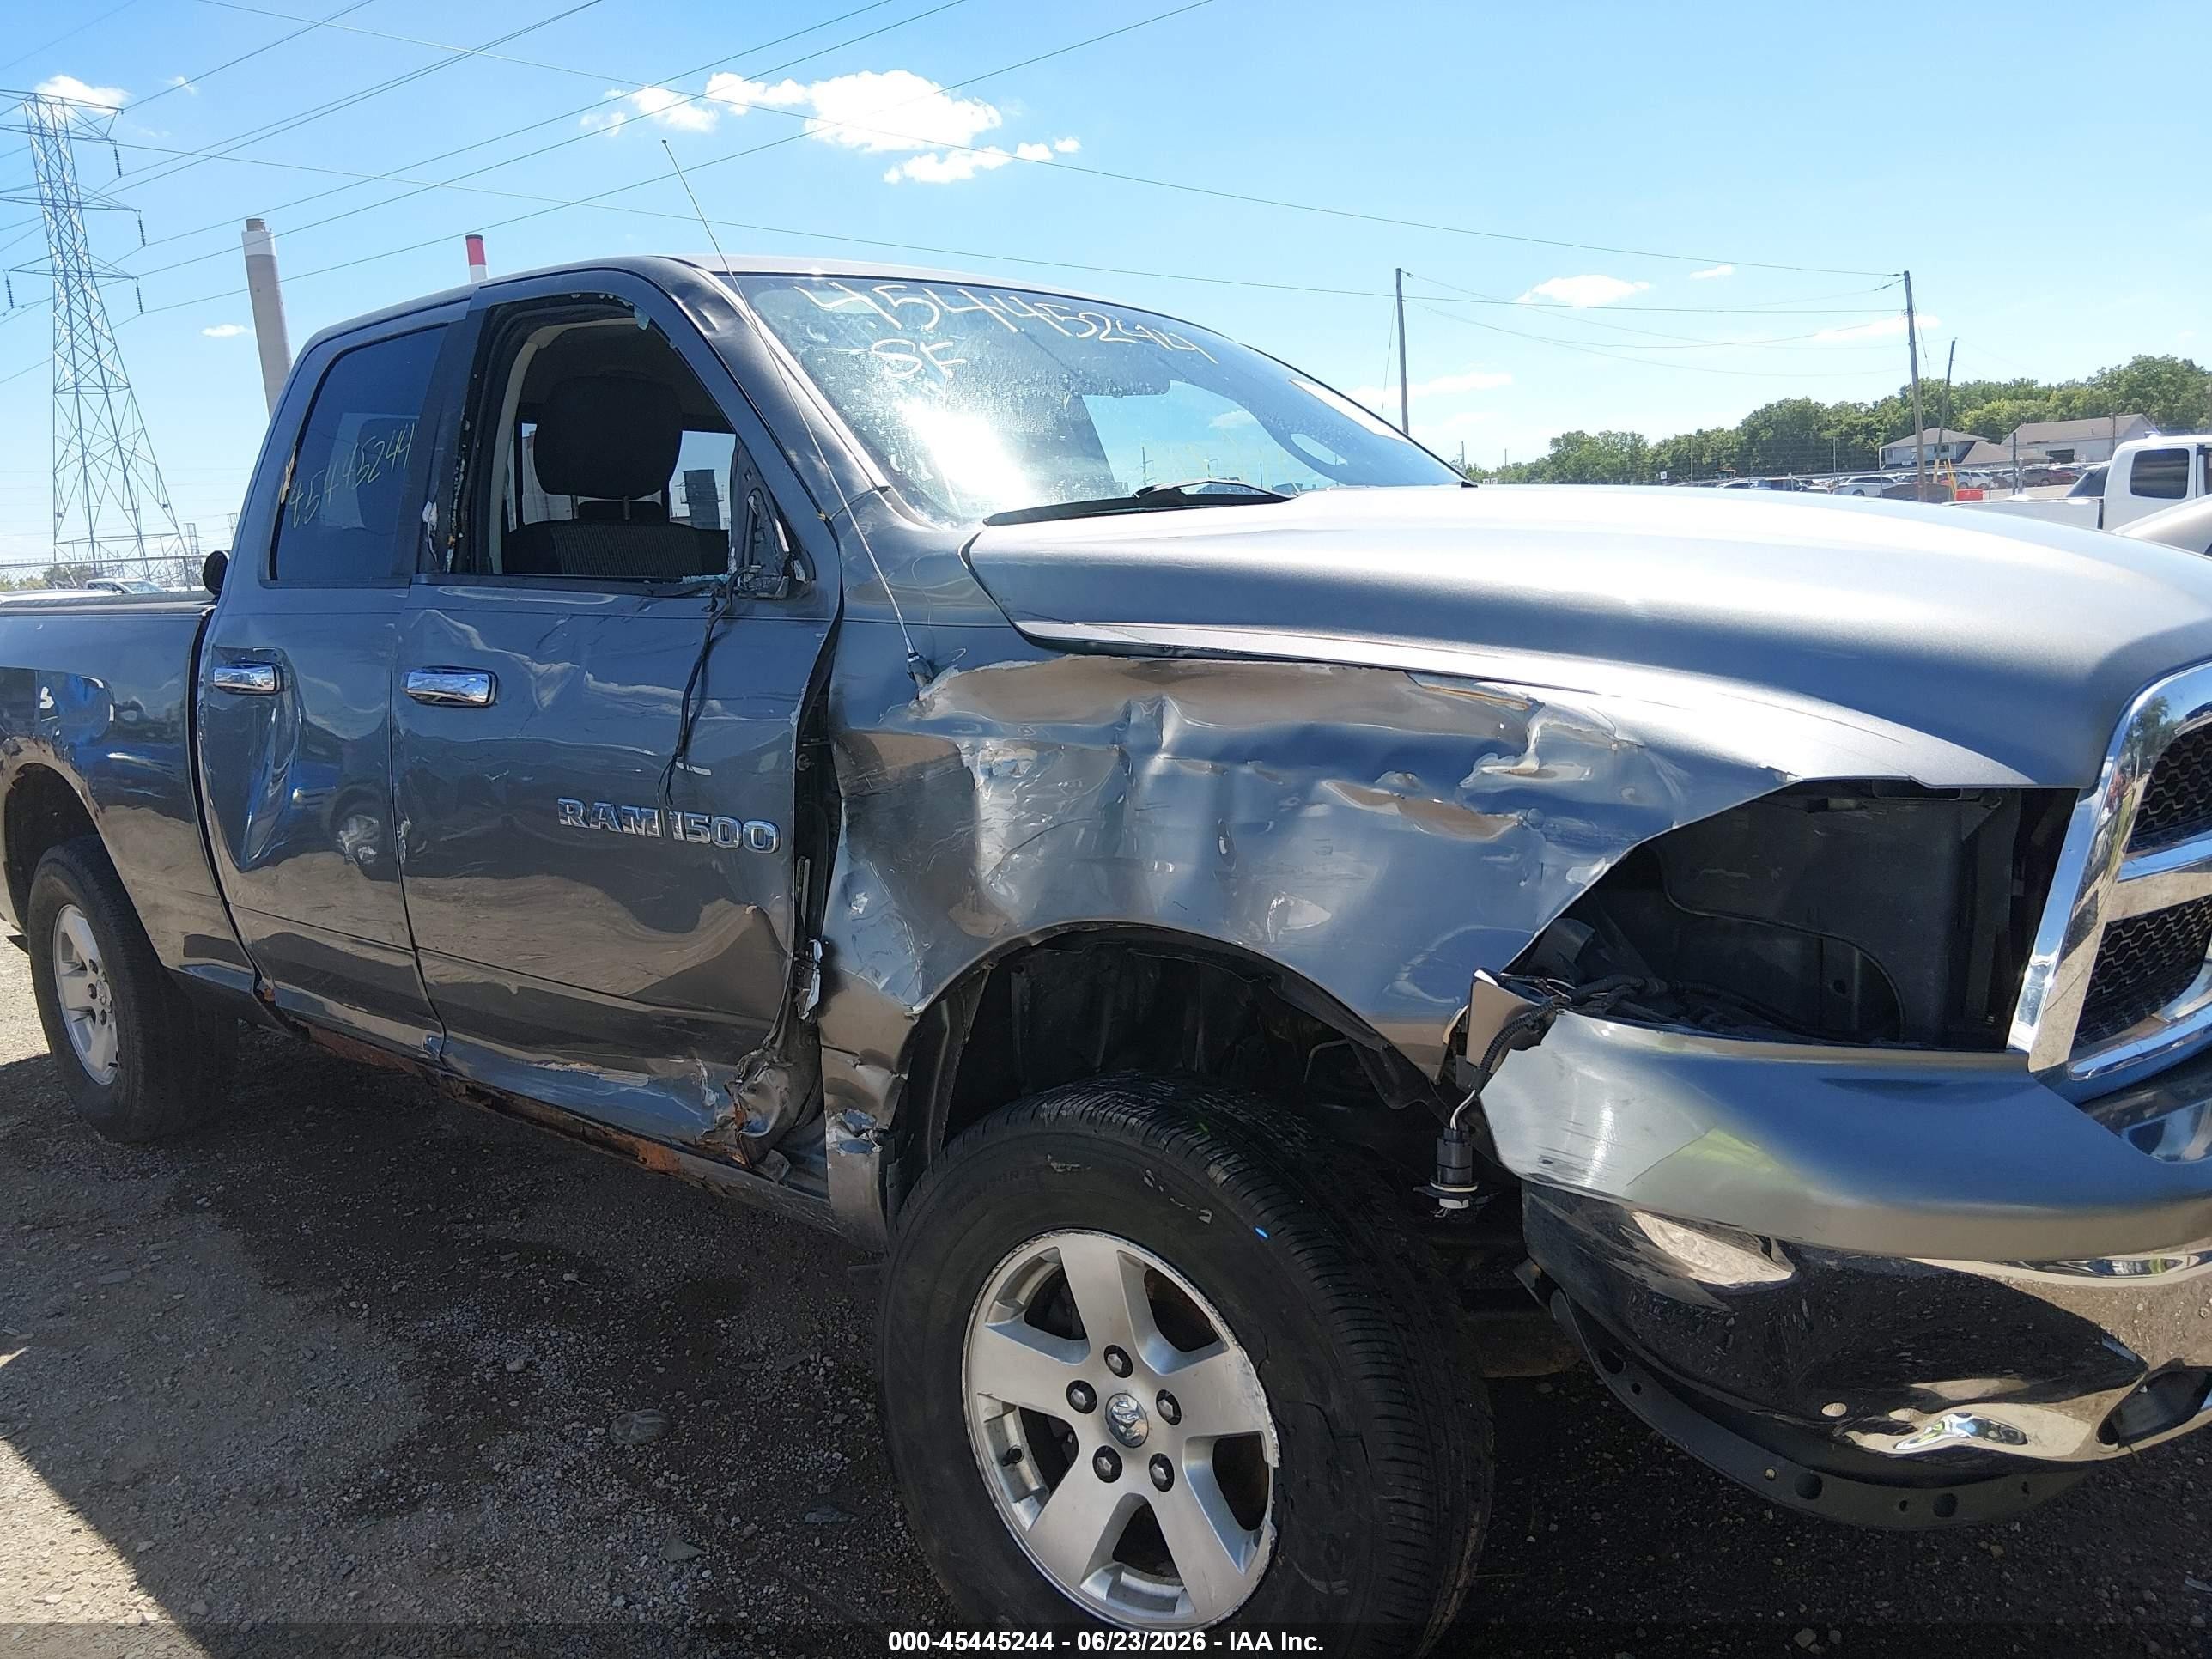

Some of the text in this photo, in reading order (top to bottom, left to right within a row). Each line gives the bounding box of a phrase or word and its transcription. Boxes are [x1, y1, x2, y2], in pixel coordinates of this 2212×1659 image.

[794, 282, 1218, 365] 45445244
[289, 422, 416, 529] 45445244
[557, 797, 781, 854] RAM 1500
